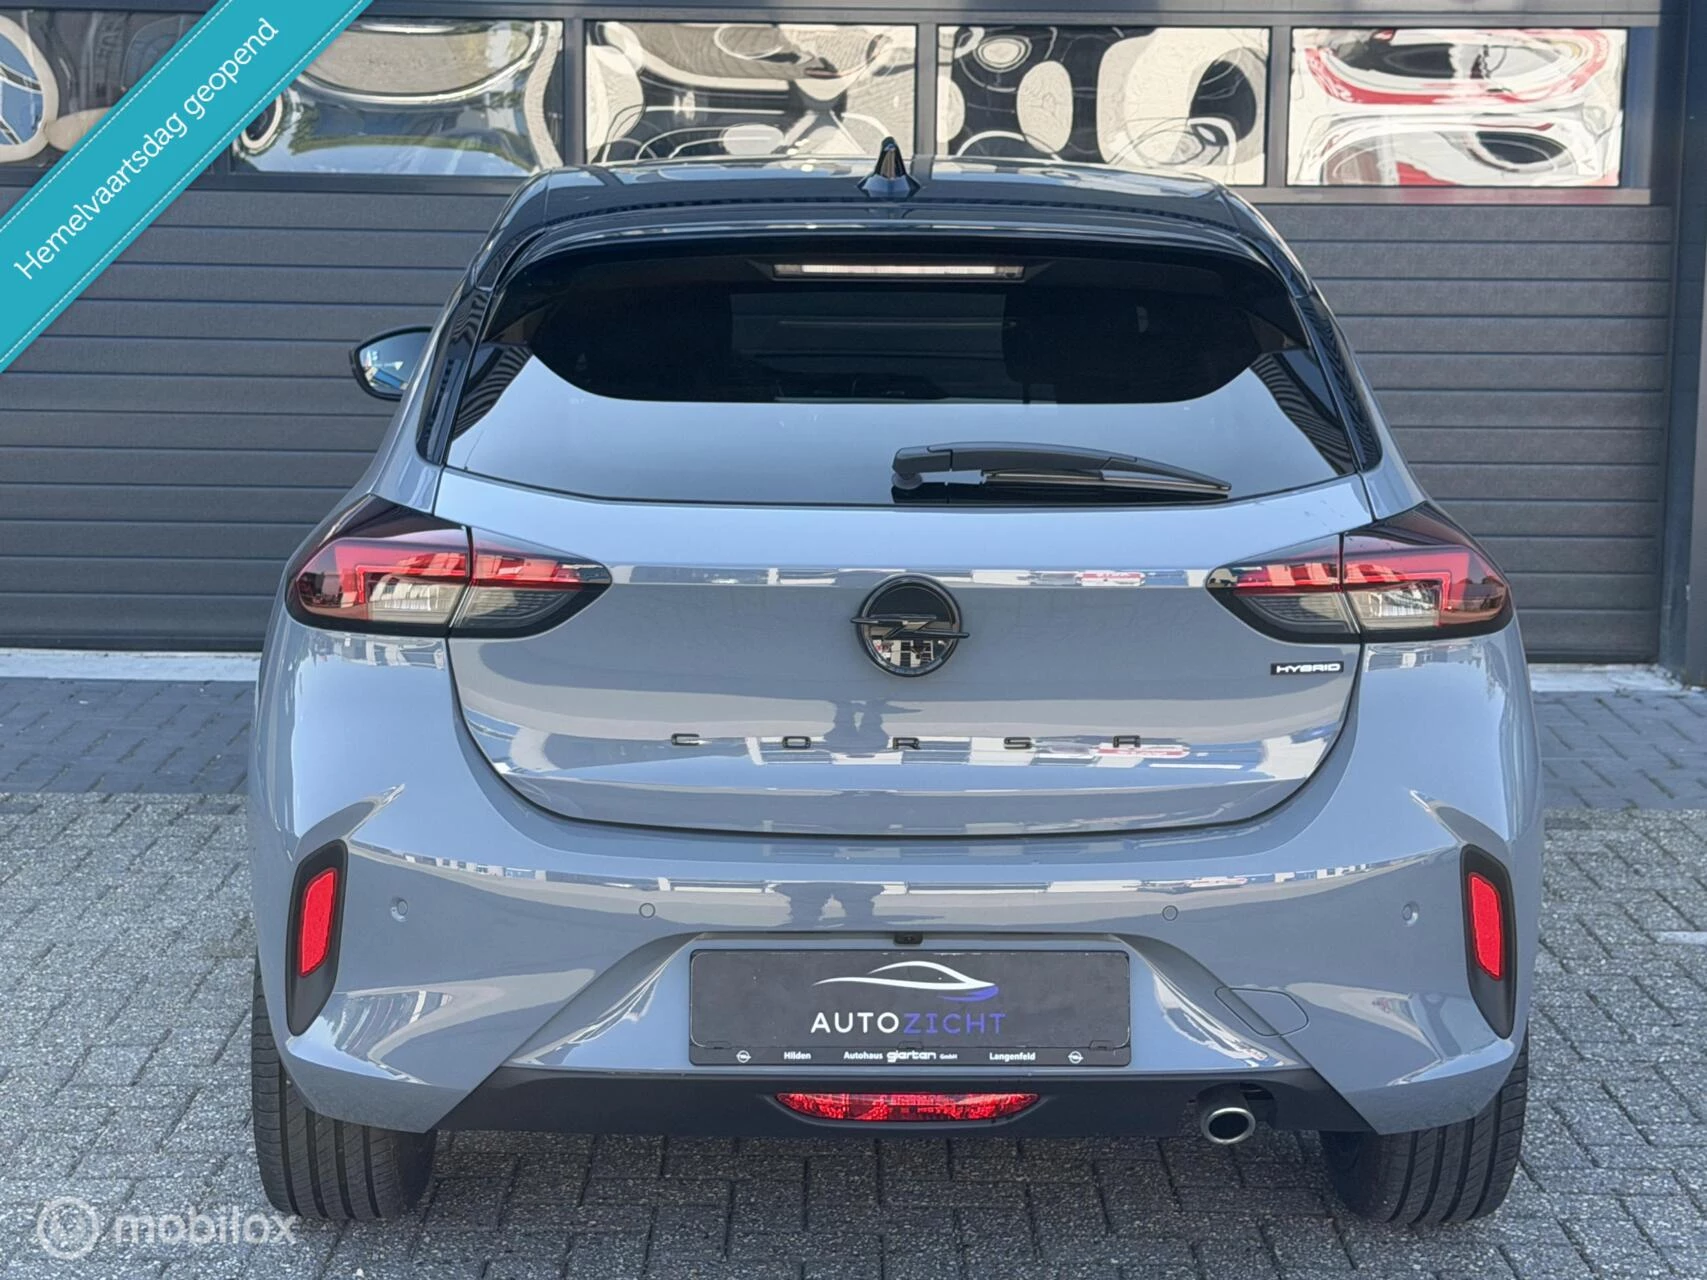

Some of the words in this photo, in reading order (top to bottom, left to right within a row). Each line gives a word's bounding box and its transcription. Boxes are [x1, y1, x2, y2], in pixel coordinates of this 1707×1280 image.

[1276, 663, 1341, 673] HYBRID
[671, 733, 1141, 750] CORSA
[810, 1012, 1006, 1034] AUTOZICHT
[783, 1051, 812, 1060] Hilden
[843, 1051, 884, 1060] Autohaus
[989, 1051, 1036, 1062] Langenfeld
